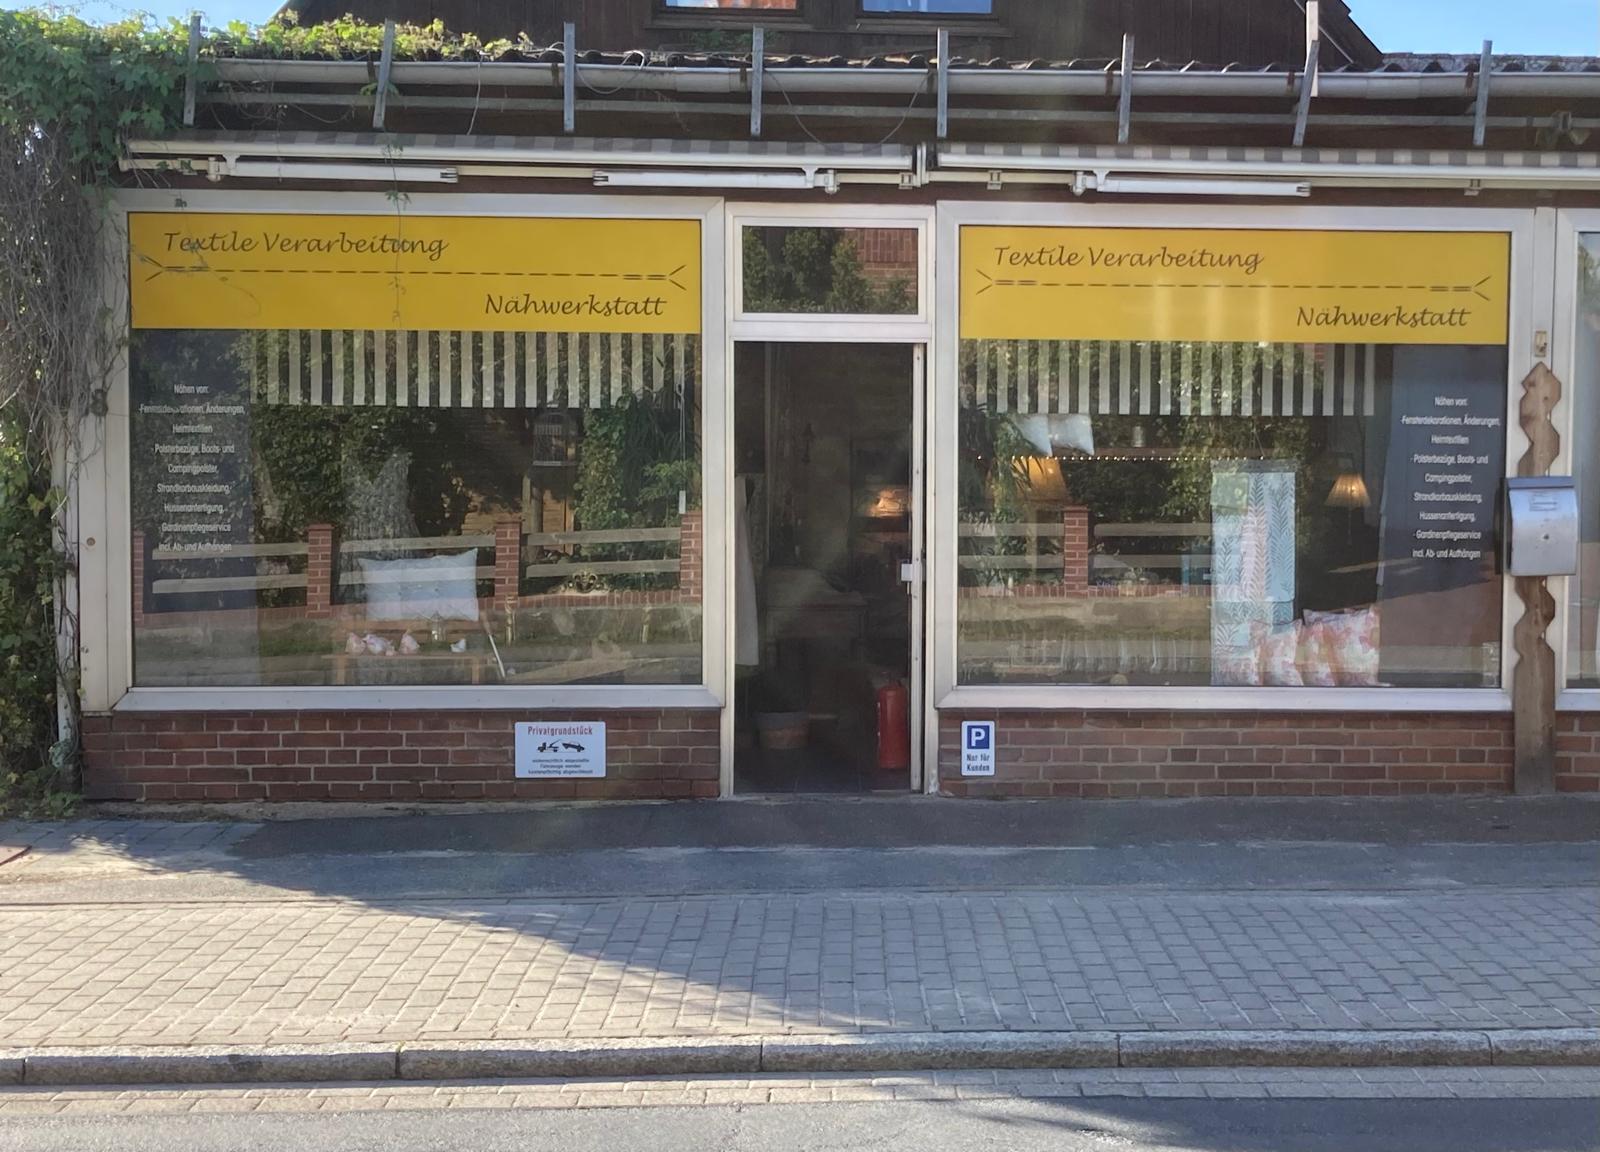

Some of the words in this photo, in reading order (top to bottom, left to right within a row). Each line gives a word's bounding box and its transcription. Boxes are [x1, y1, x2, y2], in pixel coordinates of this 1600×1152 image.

[164, 231, 258, 253] Textile
[263, 233, 449, 261] Verarbeitung
[994, 246, 1084, 267] Textile
[1088, 248, 1264, 274] Verarbeitung
[484, 293, 668, 317] Nähwerkstatt
[1296, 306, 1471, 328] Nähwerkstatt
[174, 384, 195, 394] Nähen
[1434, 396, 1455, 406] Nähen
[222, 444, 235, 453] und
[1476, 455, 1488, 464] und
[184, 543, 197, 552] und
[1436, 549, 1448, 558] und
[527, 725, 593, 736] Privatgrundstück
[970, 727, 986, 747] P
[966, 753, 978, 761] Nur
[980, 753, 990, 761] für
